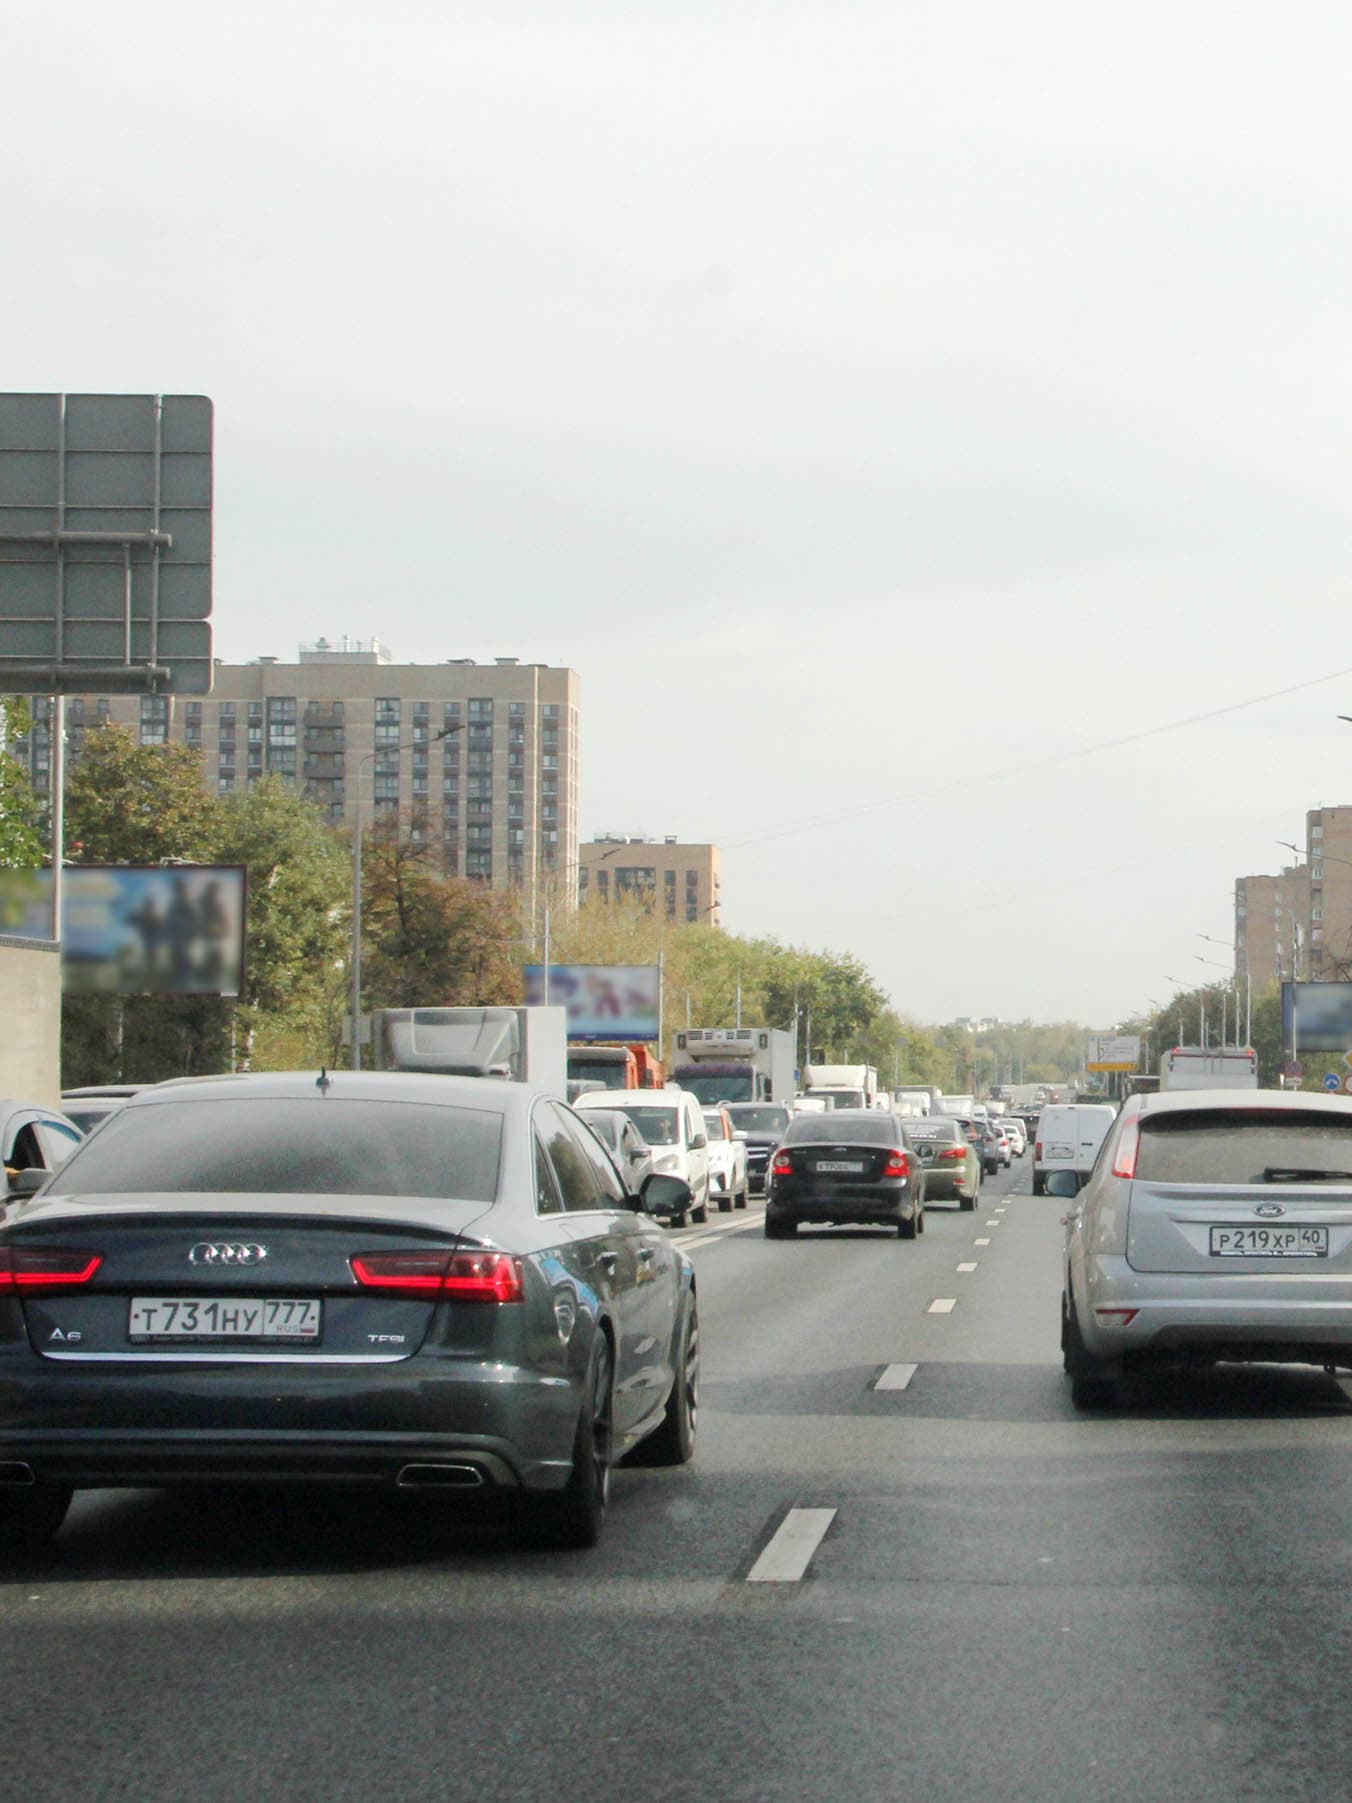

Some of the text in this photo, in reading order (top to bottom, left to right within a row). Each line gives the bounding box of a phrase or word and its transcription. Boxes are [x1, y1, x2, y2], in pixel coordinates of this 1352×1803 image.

[1220, 1230, 1320, 1248] Р219ХР 40
[141, 1302, 312, 1331] Т731НУ 777
[48, 1327, 82, 1341] A6
[367, 1334, 405, 1343] TFSI
